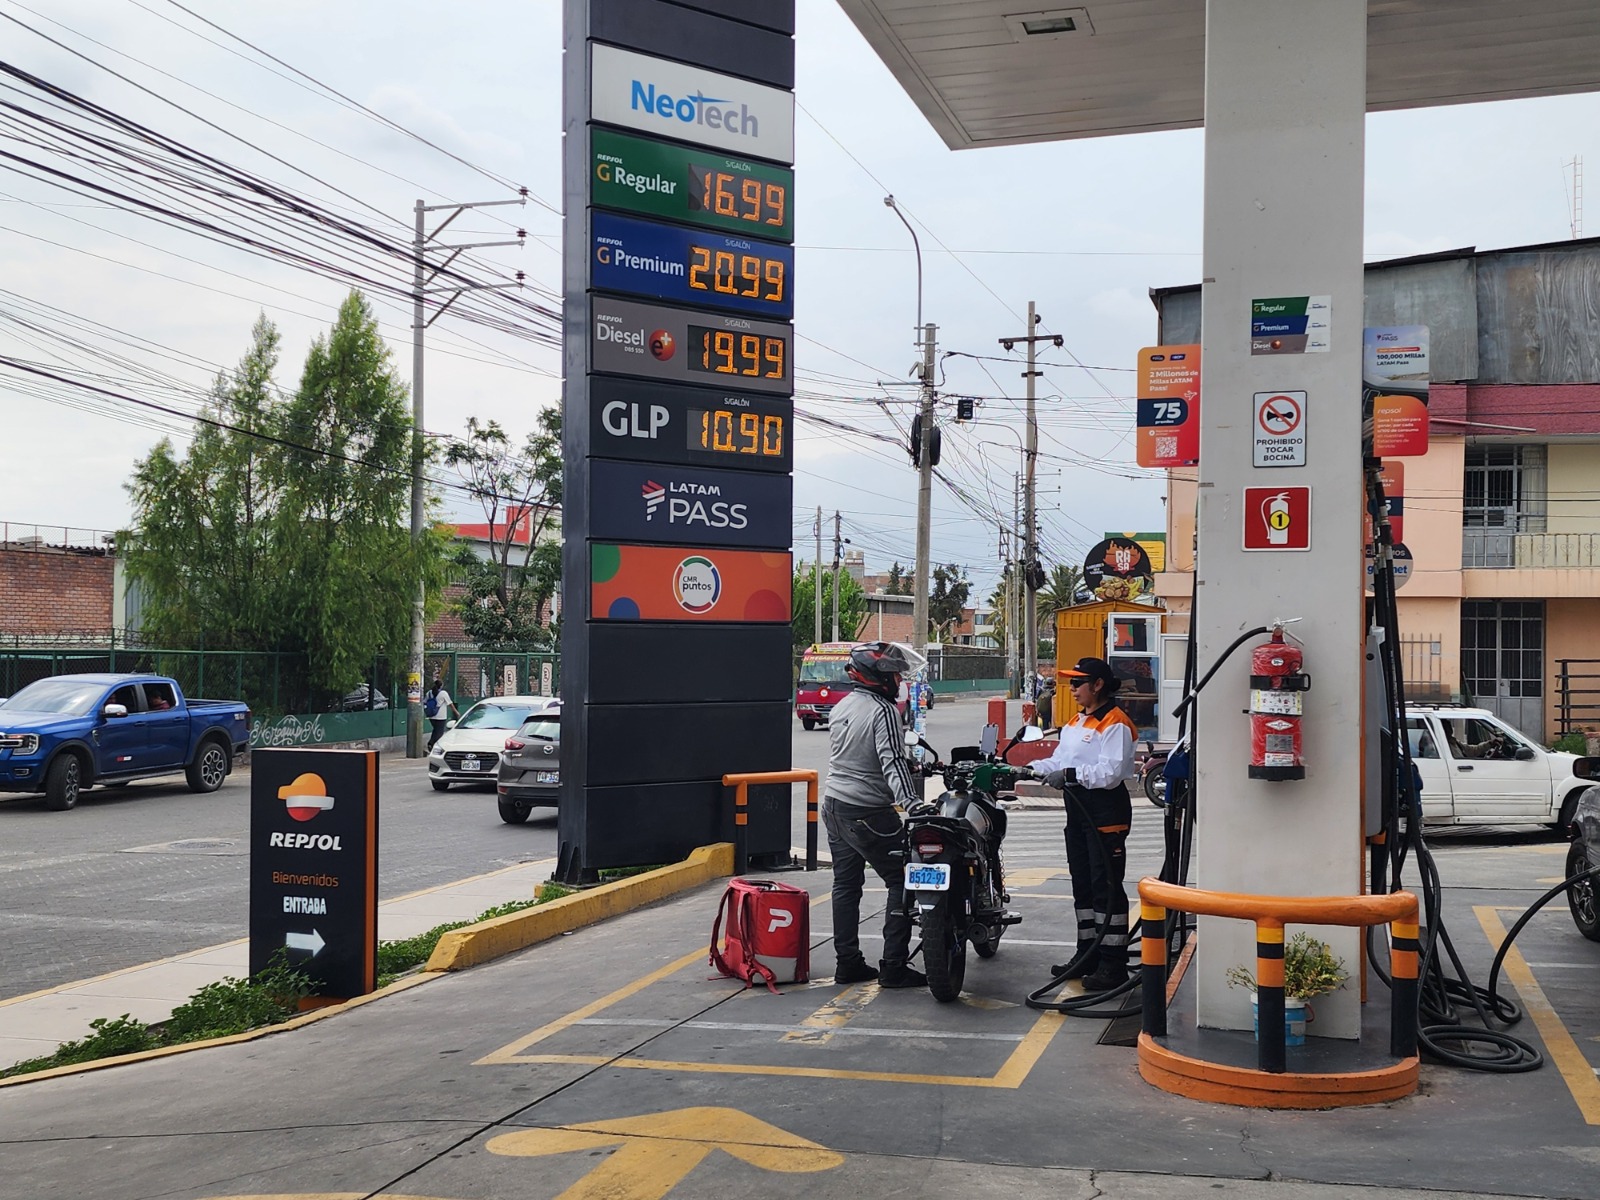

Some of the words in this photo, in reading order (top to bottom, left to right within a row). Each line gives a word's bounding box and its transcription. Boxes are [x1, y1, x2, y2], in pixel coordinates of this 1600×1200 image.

[632, 80, 758, 137] NeoTech
[597, 153, 623, 164] REPSOL
[725, 160, 751, 172] S/GALÓN
[596, 163, 610, 182] G
[615, 167, 676, 194] Regular
[703, 172, 785, 226] 16.99
[597, 236, 623, 246] REPSOL
[725, 238, 751, 250] S/GALÓN
[596, 246, 610, 264] G
[615, 249, 684, 276] Premium
[689, 246, 784, 301] 20.99
[1261, 305, 1286, 314] Regular
[725, 318, 750, 329] S/GALÓN
[1260, 324, 1289, 332] Premium
[597, 323, 644, 346] Diesel
[1253, 342, 1271, 350] Diesel
[703, 331, 784, 379] 19.99
[724, 397, 750, 407] S/GALÓN
[1153, 402, 1181, 419] 75
[602, 400, 670, 439] GLP
[701, 410, 782, 455] 10.90
[1256, 438, 1303, 446] PROHIBIDO
[1265, 446, 1294, 454] TOCAR
[1263, 454, 1295, 462] BOCINA
[669, 482, 721, 496] LATAM
[669, 498, 748, 529] PASS
[1276, 513, 1283, 527] 1
[682, 581, 712, 592] puntos
[269, 832, 342, 851] REPSOL
[272, 871, 339, 887] Bienvenidos
[283, 896, 327, 915] ENTRADA
